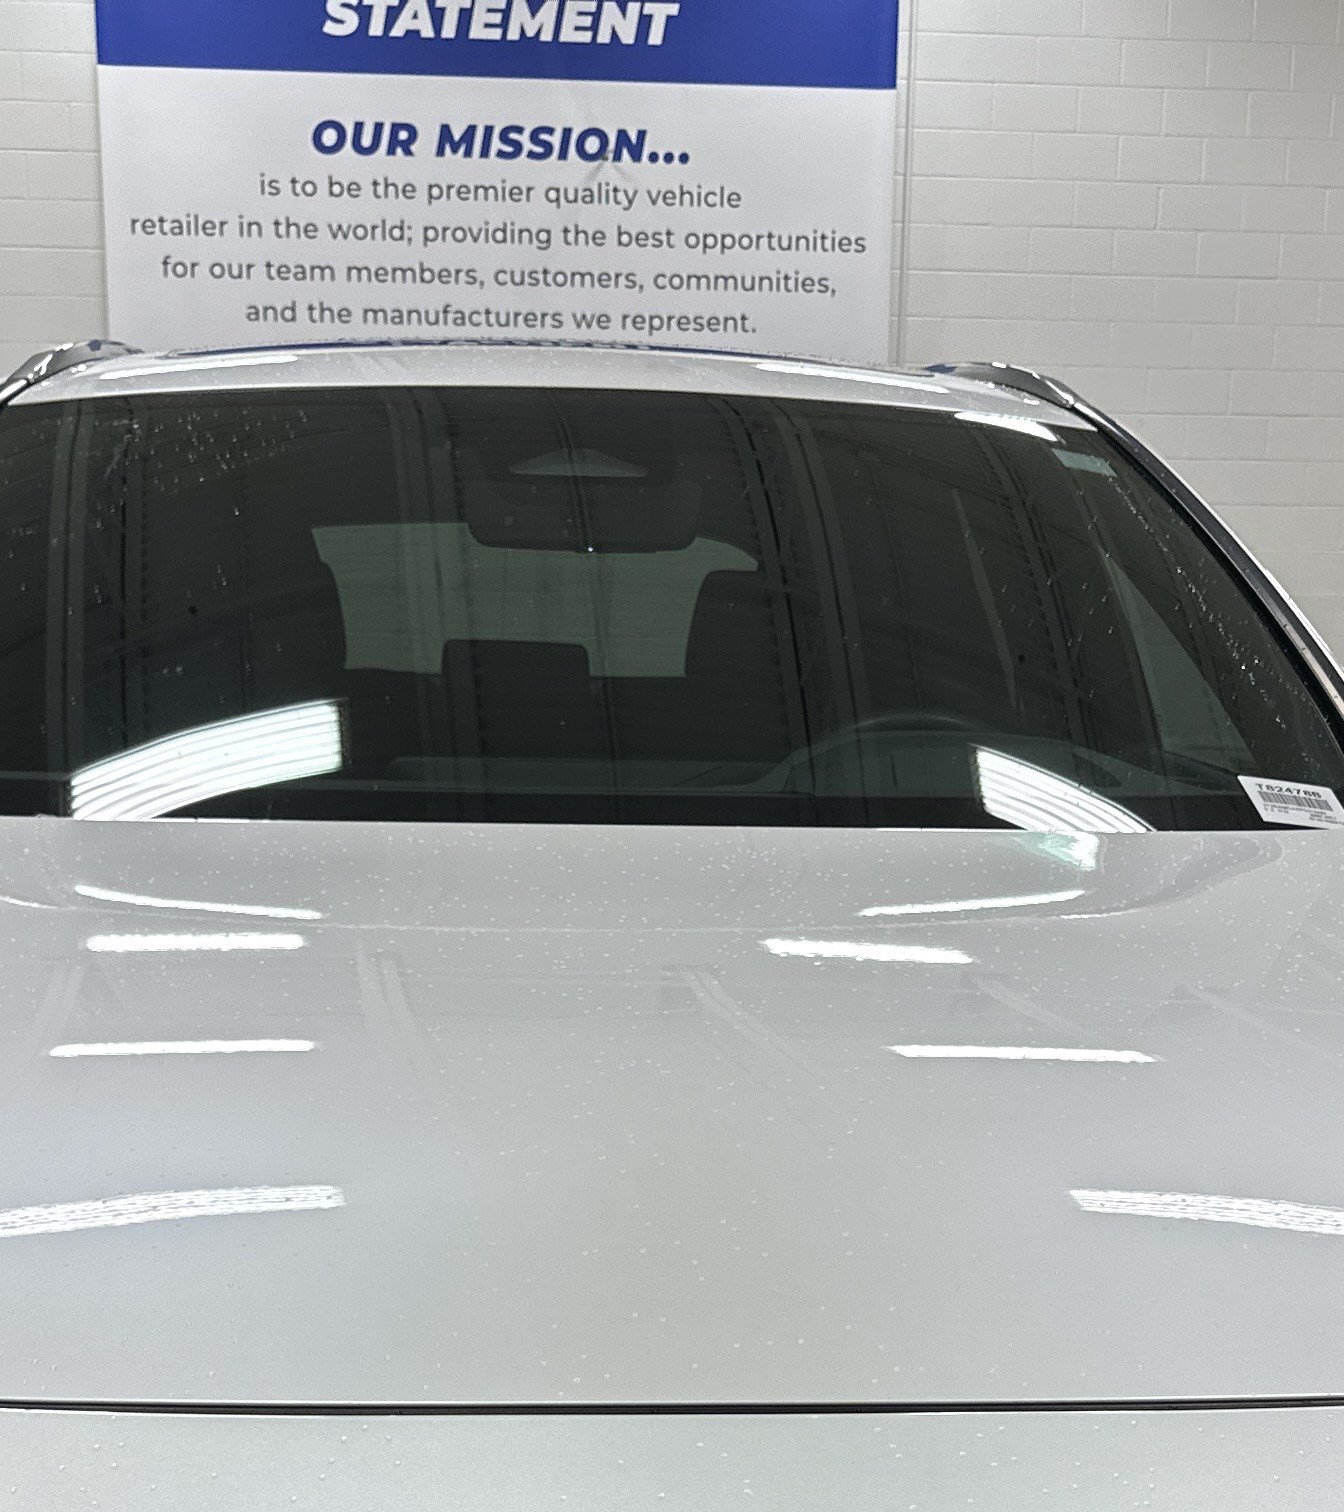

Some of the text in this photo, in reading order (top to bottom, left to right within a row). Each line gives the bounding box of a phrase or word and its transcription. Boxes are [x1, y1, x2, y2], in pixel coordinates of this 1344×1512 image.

[321, 0, 680, 47] STATEMENT
[311, 119, 691, 166] OUR MISSION...
[259, 172, 743, 212] is to be the premier quality vehicle
[130, 212, 868, 257] retailer in the world; providing the best opportunities
[160, 253, 837, 299] for our team members, customers, communities,
[245, 297, 758, 338] and the manufacturers we represent.
